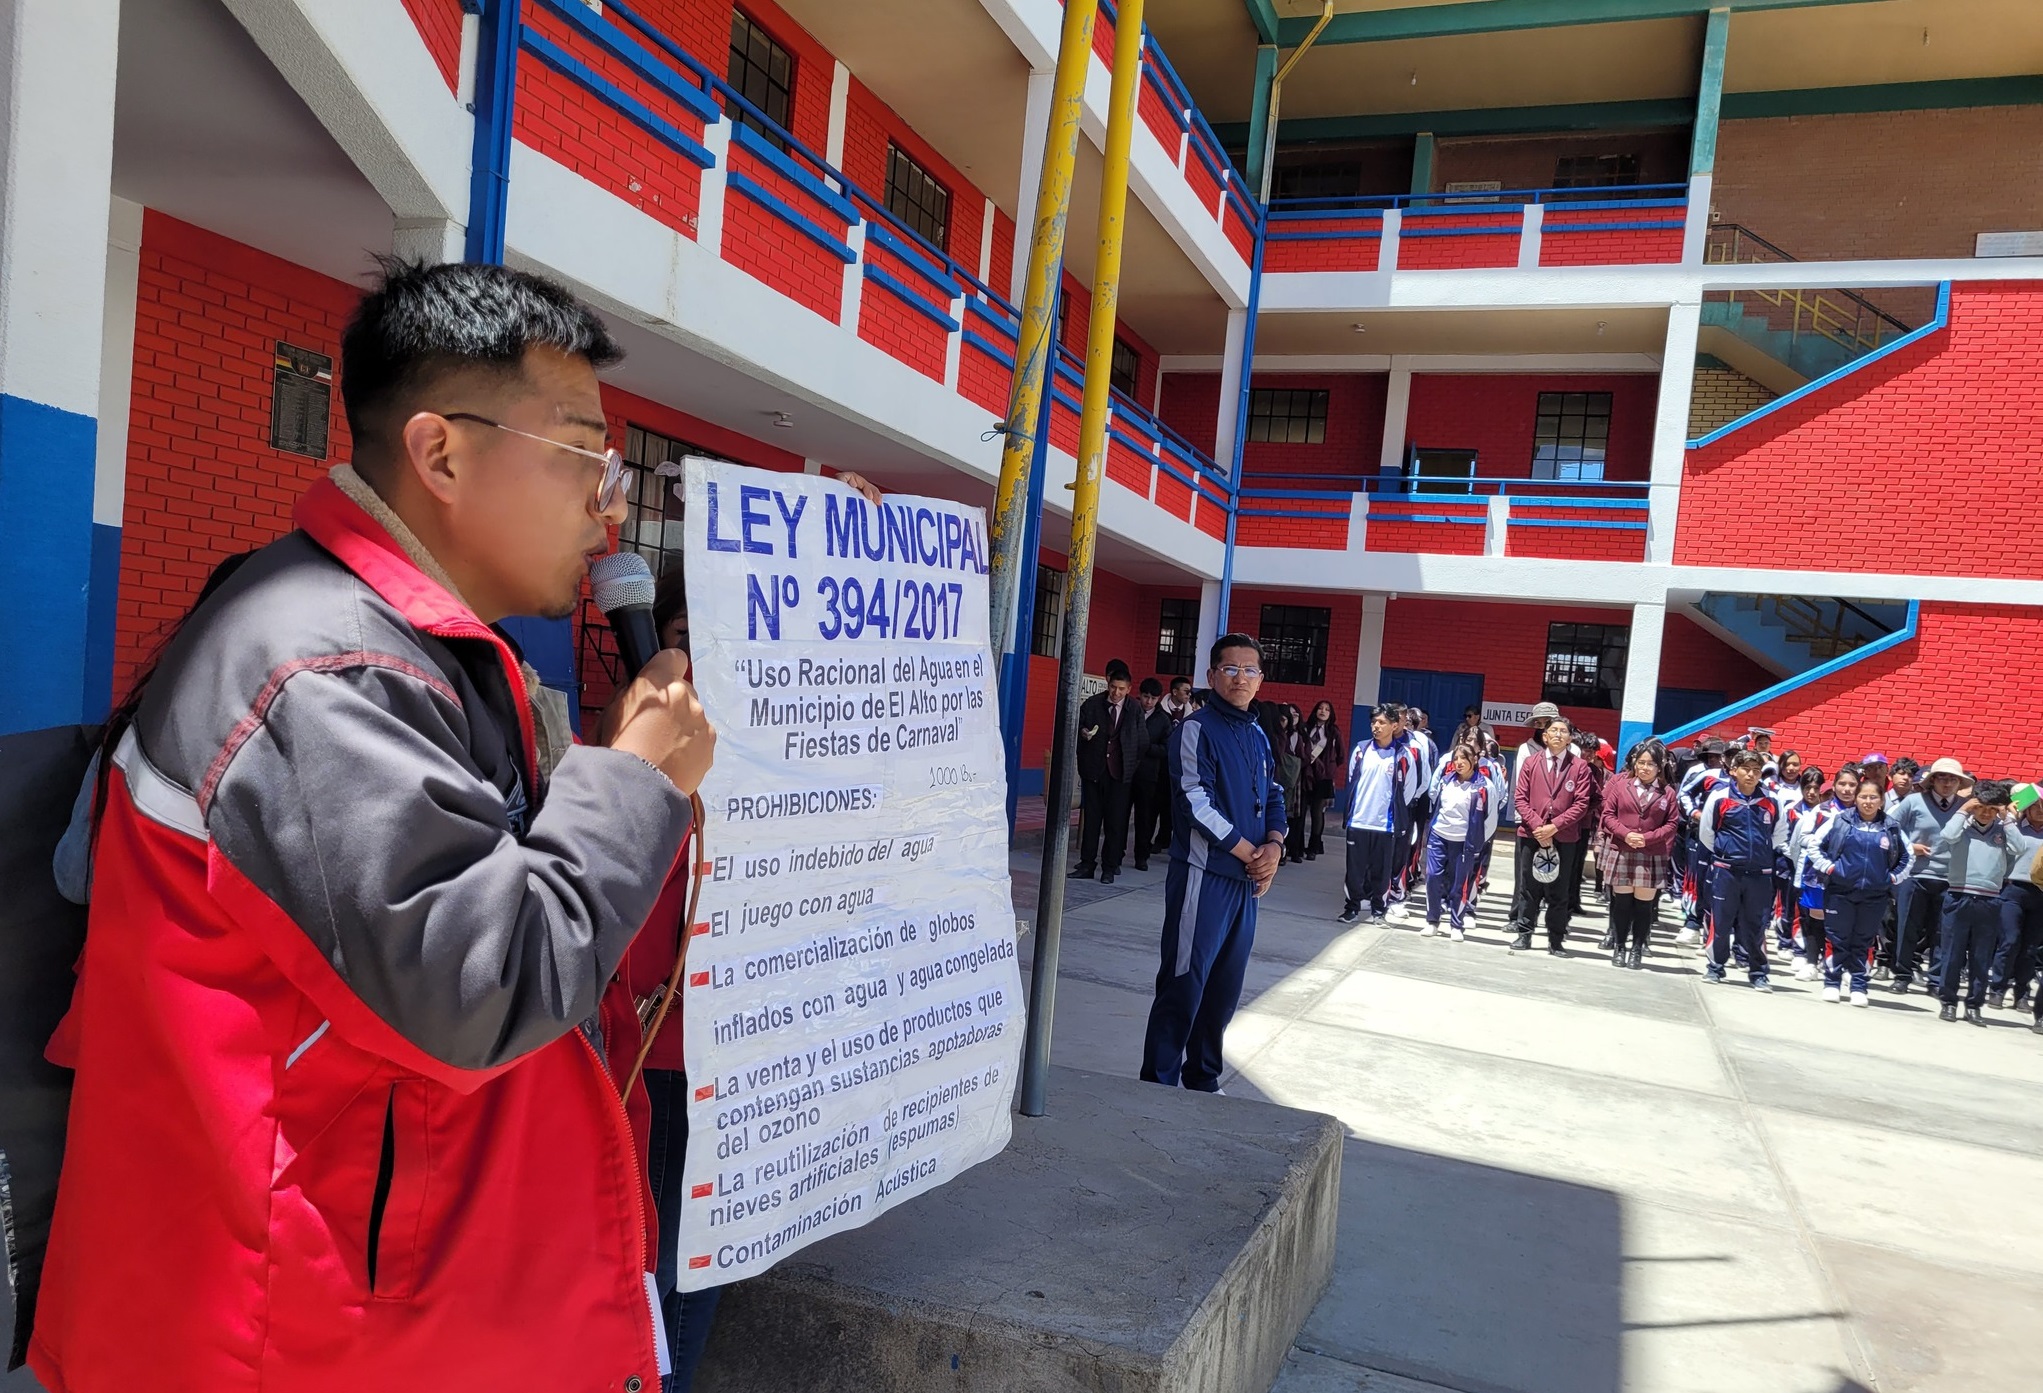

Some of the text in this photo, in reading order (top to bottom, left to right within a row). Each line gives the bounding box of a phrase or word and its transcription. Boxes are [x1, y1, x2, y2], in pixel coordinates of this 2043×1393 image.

[707, 481, 989, 575] LEY MUNICIPAL
[817, 576, 963, 640] 394/2017
[799, 658, 885, 686] Racional
[893, 662, 914, 683] del
[919, 658, 954, 688] Agua
[955, 660, 970, 678] en
[973, 653, 983, 677] el
[750, 685, 983, 729] Municipio de El Alto por las
[1483, 709, 1512, 721] JUNTA
[785, 731, 860, 759] Fiestas
[868, 726, 890, 751] de
[726, 788, 878, 821] PROHIBICIONES:
[930, 766, 958, 788] 1000
[713, 836, 934, 881] El uso indebido del agua
[711, 887, 874, 937] El juego con agua
[712, 912, 975, 989] La comercialización de globos
[714, 939, 1013, 1045] inflados con agua y agua congelada
[714, 990, 1002, 1101] La venta y el uso de productos que
[717, 1021, 1002, 1130] contengan sustancias agotadoras
[717, 1106, 820, 1160] del ozono
[719, 1065, 999, 1197] La reutilización de recipientes de
[710, 1186, 781, 1226] nieves
[789, 1148, 878, 1202] artificiales
[717, 1156, 936, 1269] Contaminación Acústica
